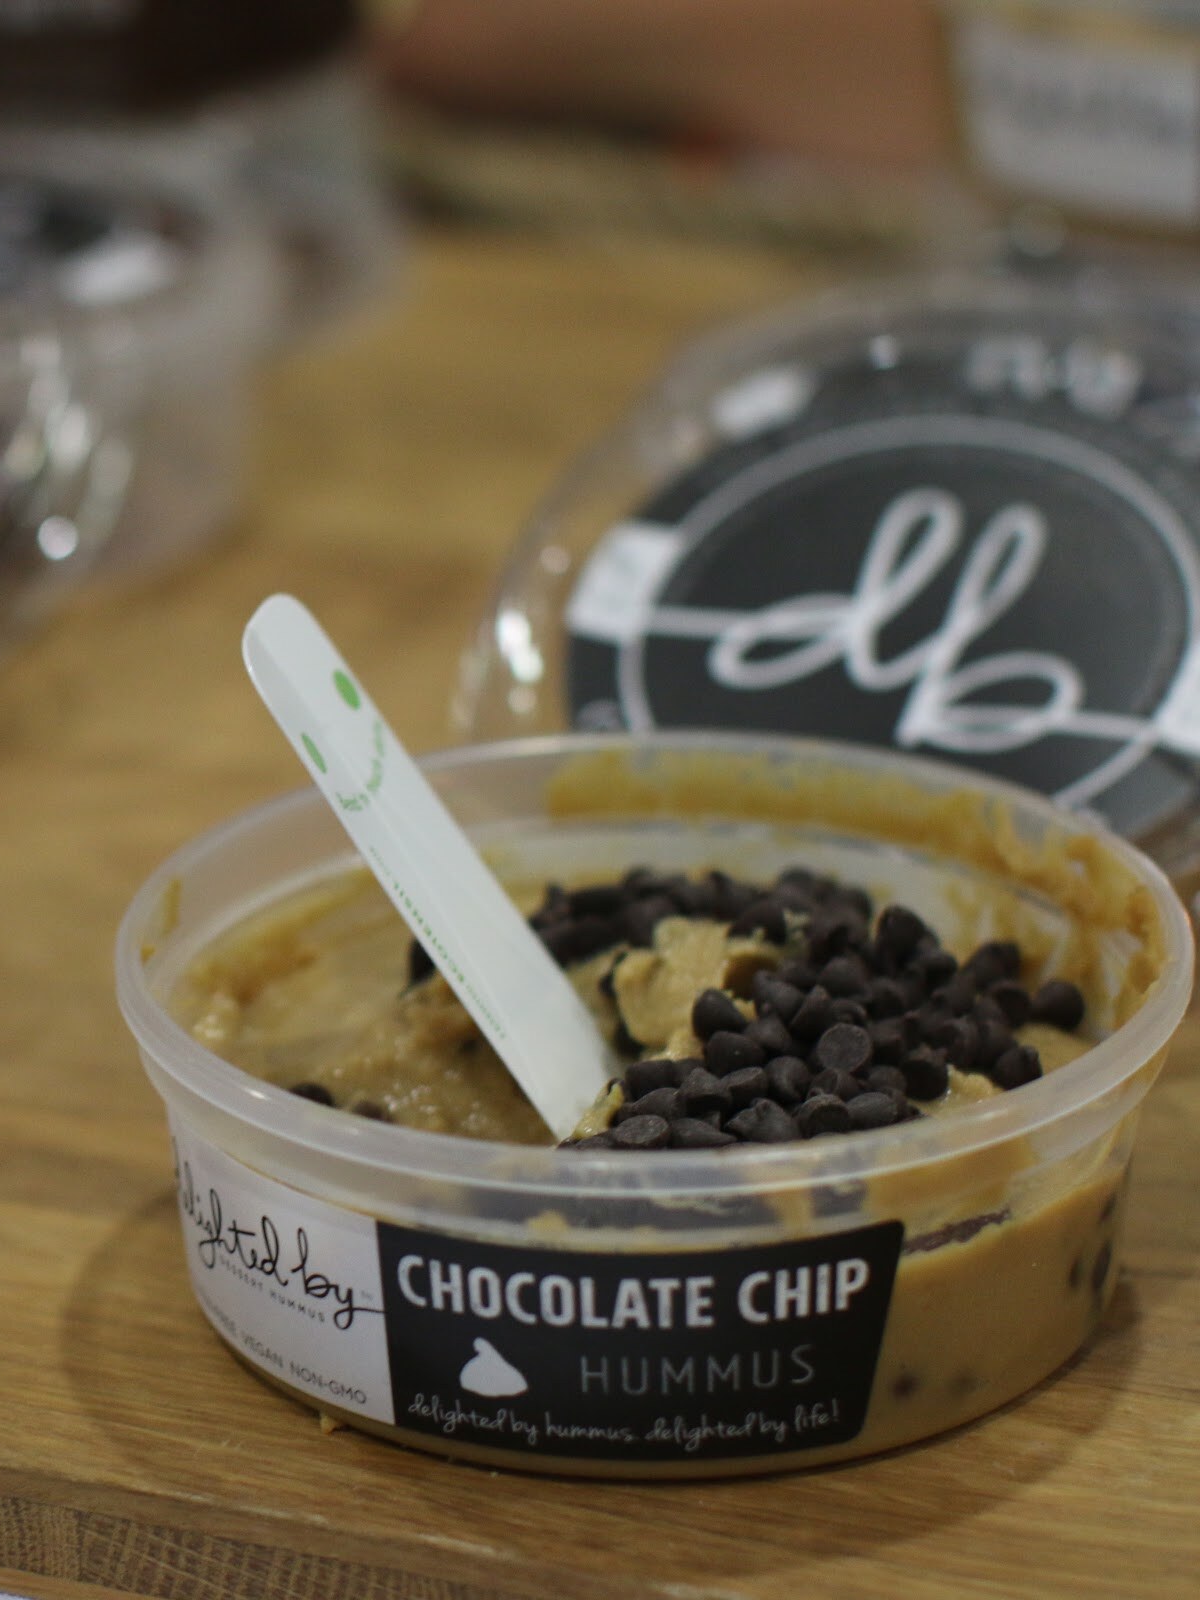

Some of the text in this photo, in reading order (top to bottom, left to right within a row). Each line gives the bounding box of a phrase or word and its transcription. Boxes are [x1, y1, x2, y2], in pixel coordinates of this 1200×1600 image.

[269, 1290, 326, 1323] HUMMUS
[290, 1227, 387, 1331] by
[397, 1253, 871, 1330] CHOCOLATE CHIP
[289, 1358, 367, 1405] NON-GMO
[579, 1343, 815, 1396] HUMMUS
[408, 1392, 507, 1433] delighted
[509, 1409, 538, 1446] by
[645, 1411, 757, 1453] delighted
[758, 1411, 788, 1443] by
[793, 1398, 839, 1433] life!
